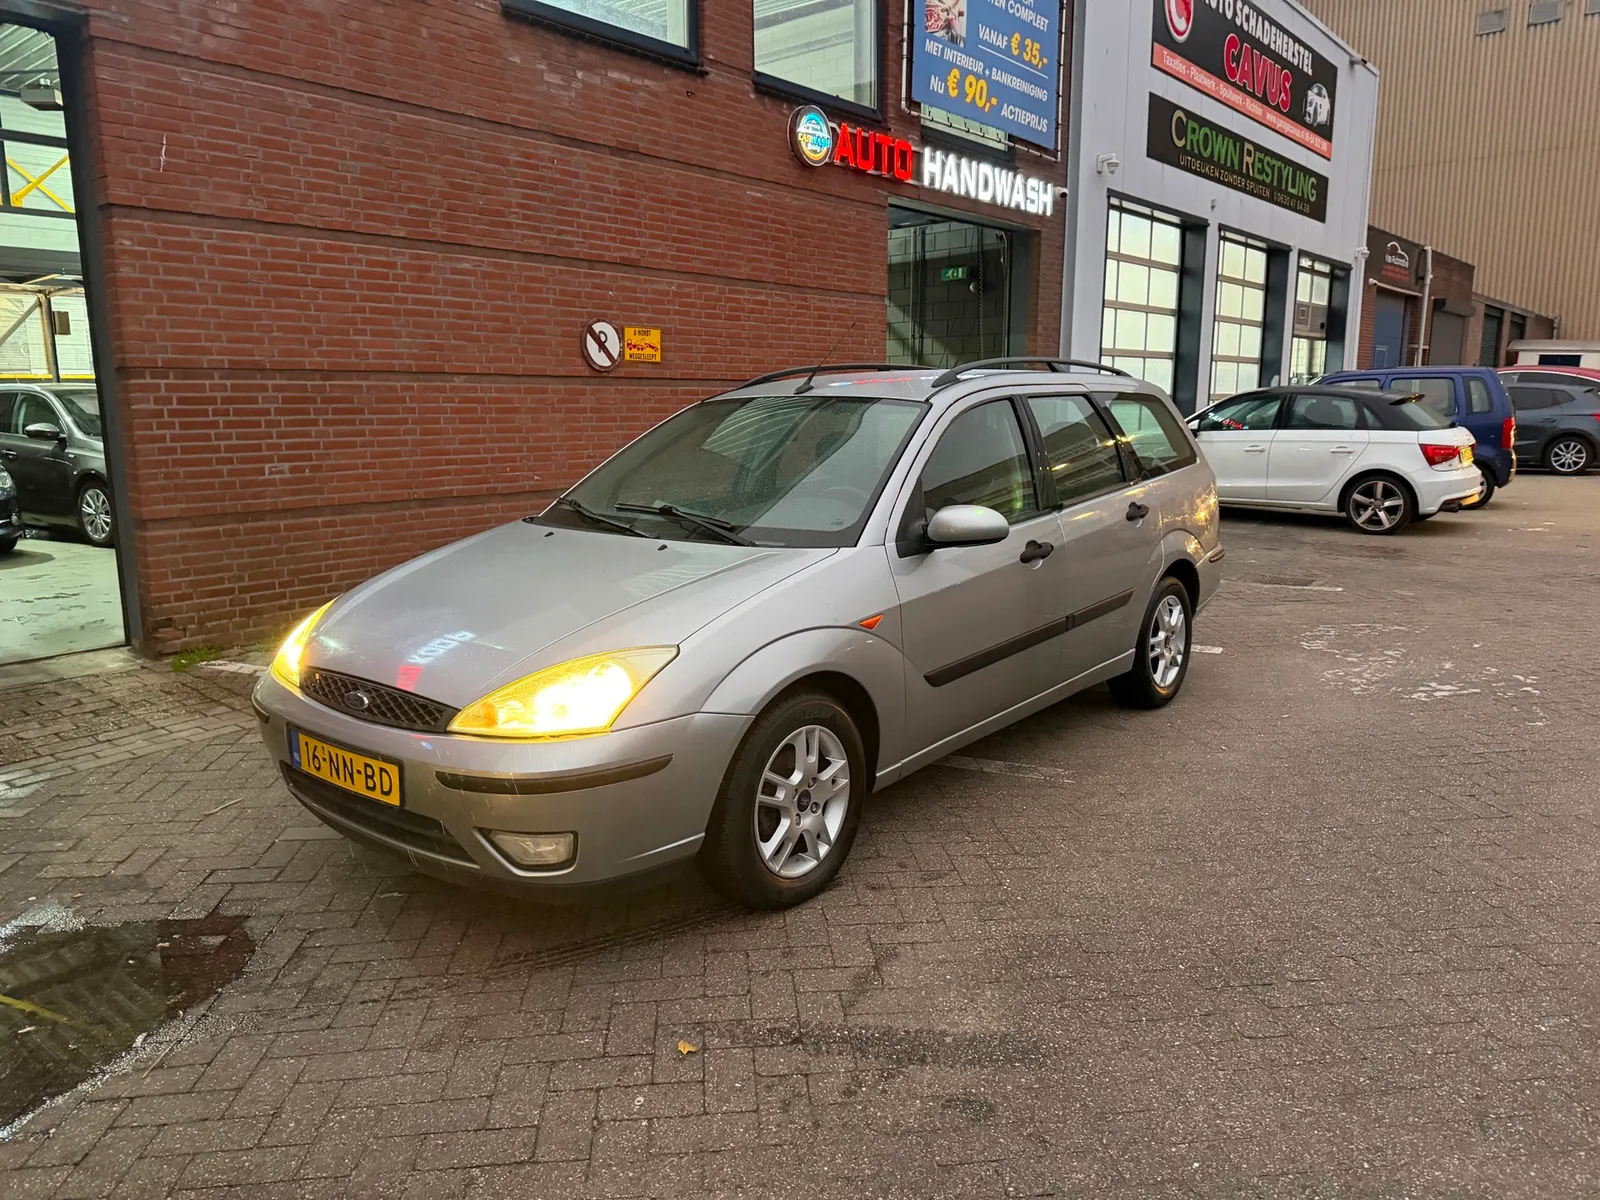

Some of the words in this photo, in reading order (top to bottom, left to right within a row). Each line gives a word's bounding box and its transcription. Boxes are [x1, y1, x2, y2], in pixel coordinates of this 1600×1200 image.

[978, 23, 1008, 50] VANAF
[1010, 32, 1021, 56] €
[1022, 38, 1048, 69] 35,-
[1008, 0, 1049, 32] COMPLEET
[1204, 0, 1234, 20] TO
[1235, 0, 1313, 76] SCHADEHERSTEL
[925, 39, 943, 56] MET
[943, 47, 984, 75] INTERIEUR
[985, 68, 990, 77] +
[991, 67, 1048, 102] BANKREINIGING
[946, 68, 961, 98] €
[964, 74, 998, 112] 90,-
[1001, 103, 1048, 133] ACTIEPRIJS
[1224, 33, 1293, 112] CAVUS
[833, 122, 913, 181] AUTO
[922, 147, 1053, 217] HANDWASH
[1171, 109, 1240, 170] CROWN
[1242, 141, 1318, 202] RESTYLING
[1179, 153, 1220, 178] UITDEUKEN
[1220, 169, 1246, 188] ZONDER
[1246, 180, 1270, 199] SPUITEN
[305, 741, 392, 796] 16-NN-BD
